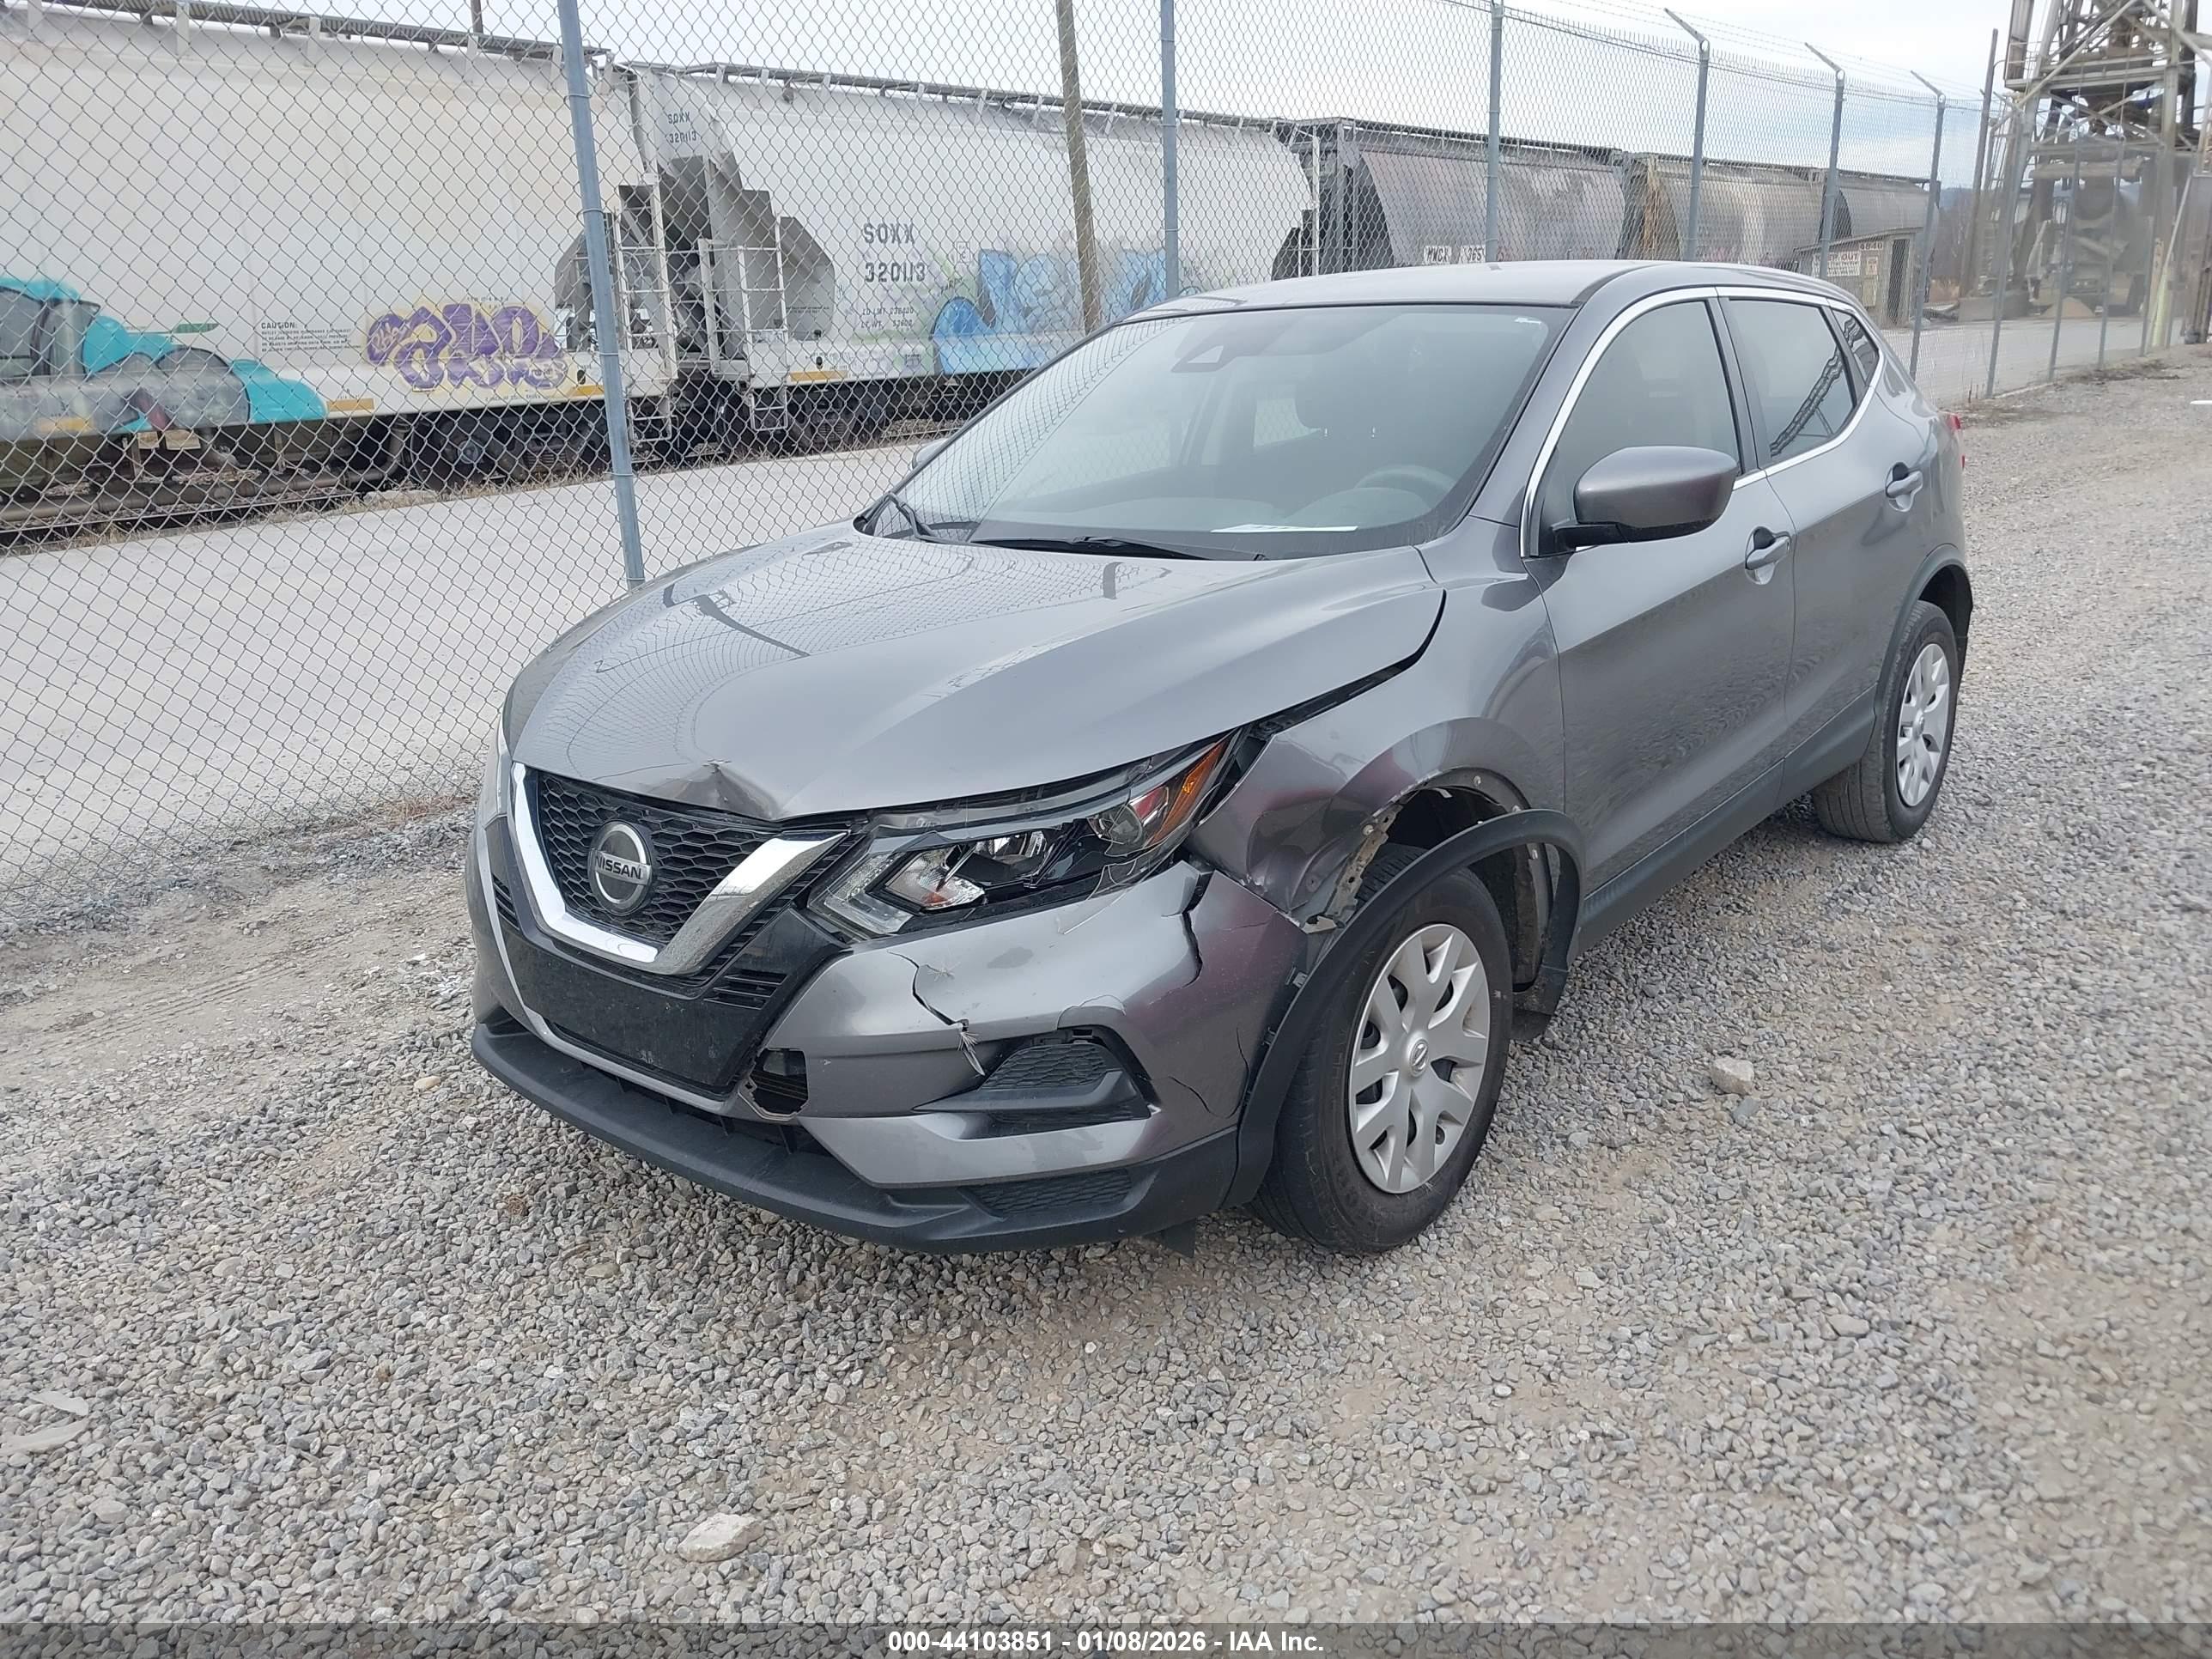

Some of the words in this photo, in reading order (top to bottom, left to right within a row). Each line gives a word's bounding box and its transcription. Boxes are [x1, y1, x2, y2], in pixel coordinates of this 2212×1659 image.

[667, 111, 690, 125] SOXX
[863, 222, 915, 244] SOXX
[865, 261, 926, 283] 320113
[596, 855, 641, 880] NISSAN
